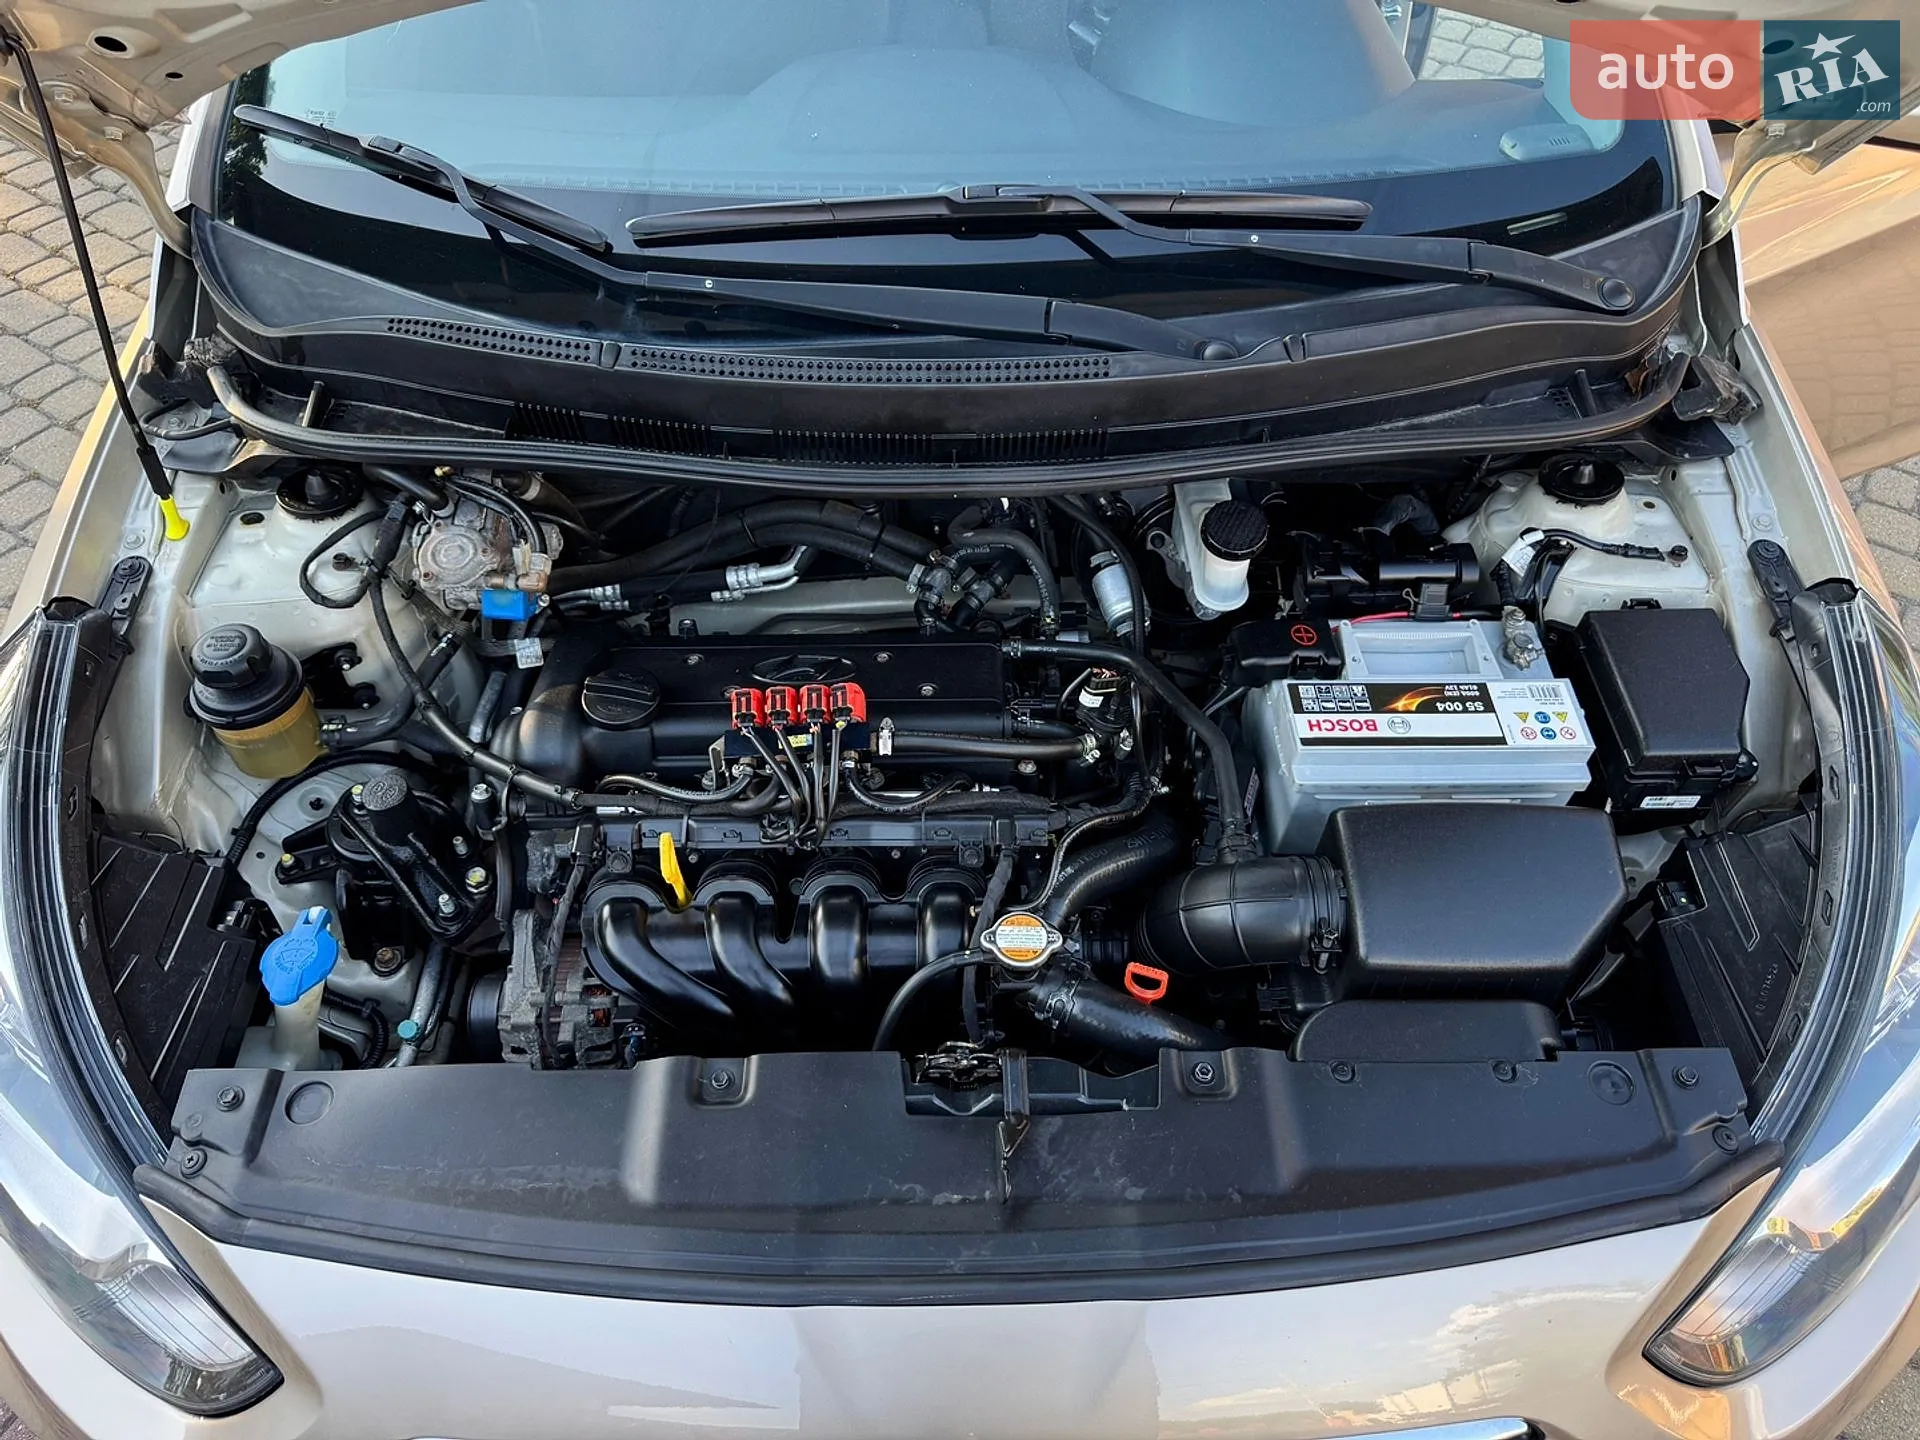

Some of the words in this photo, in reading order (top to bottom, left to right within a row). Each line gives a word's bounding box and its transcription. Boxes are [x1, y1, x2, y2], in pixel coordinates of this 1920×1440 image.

[1436, 701, 1463, 711] 004
[1465, 701, 1485, 711] S5
[1307, 719, 1378, 732] BOSCH
